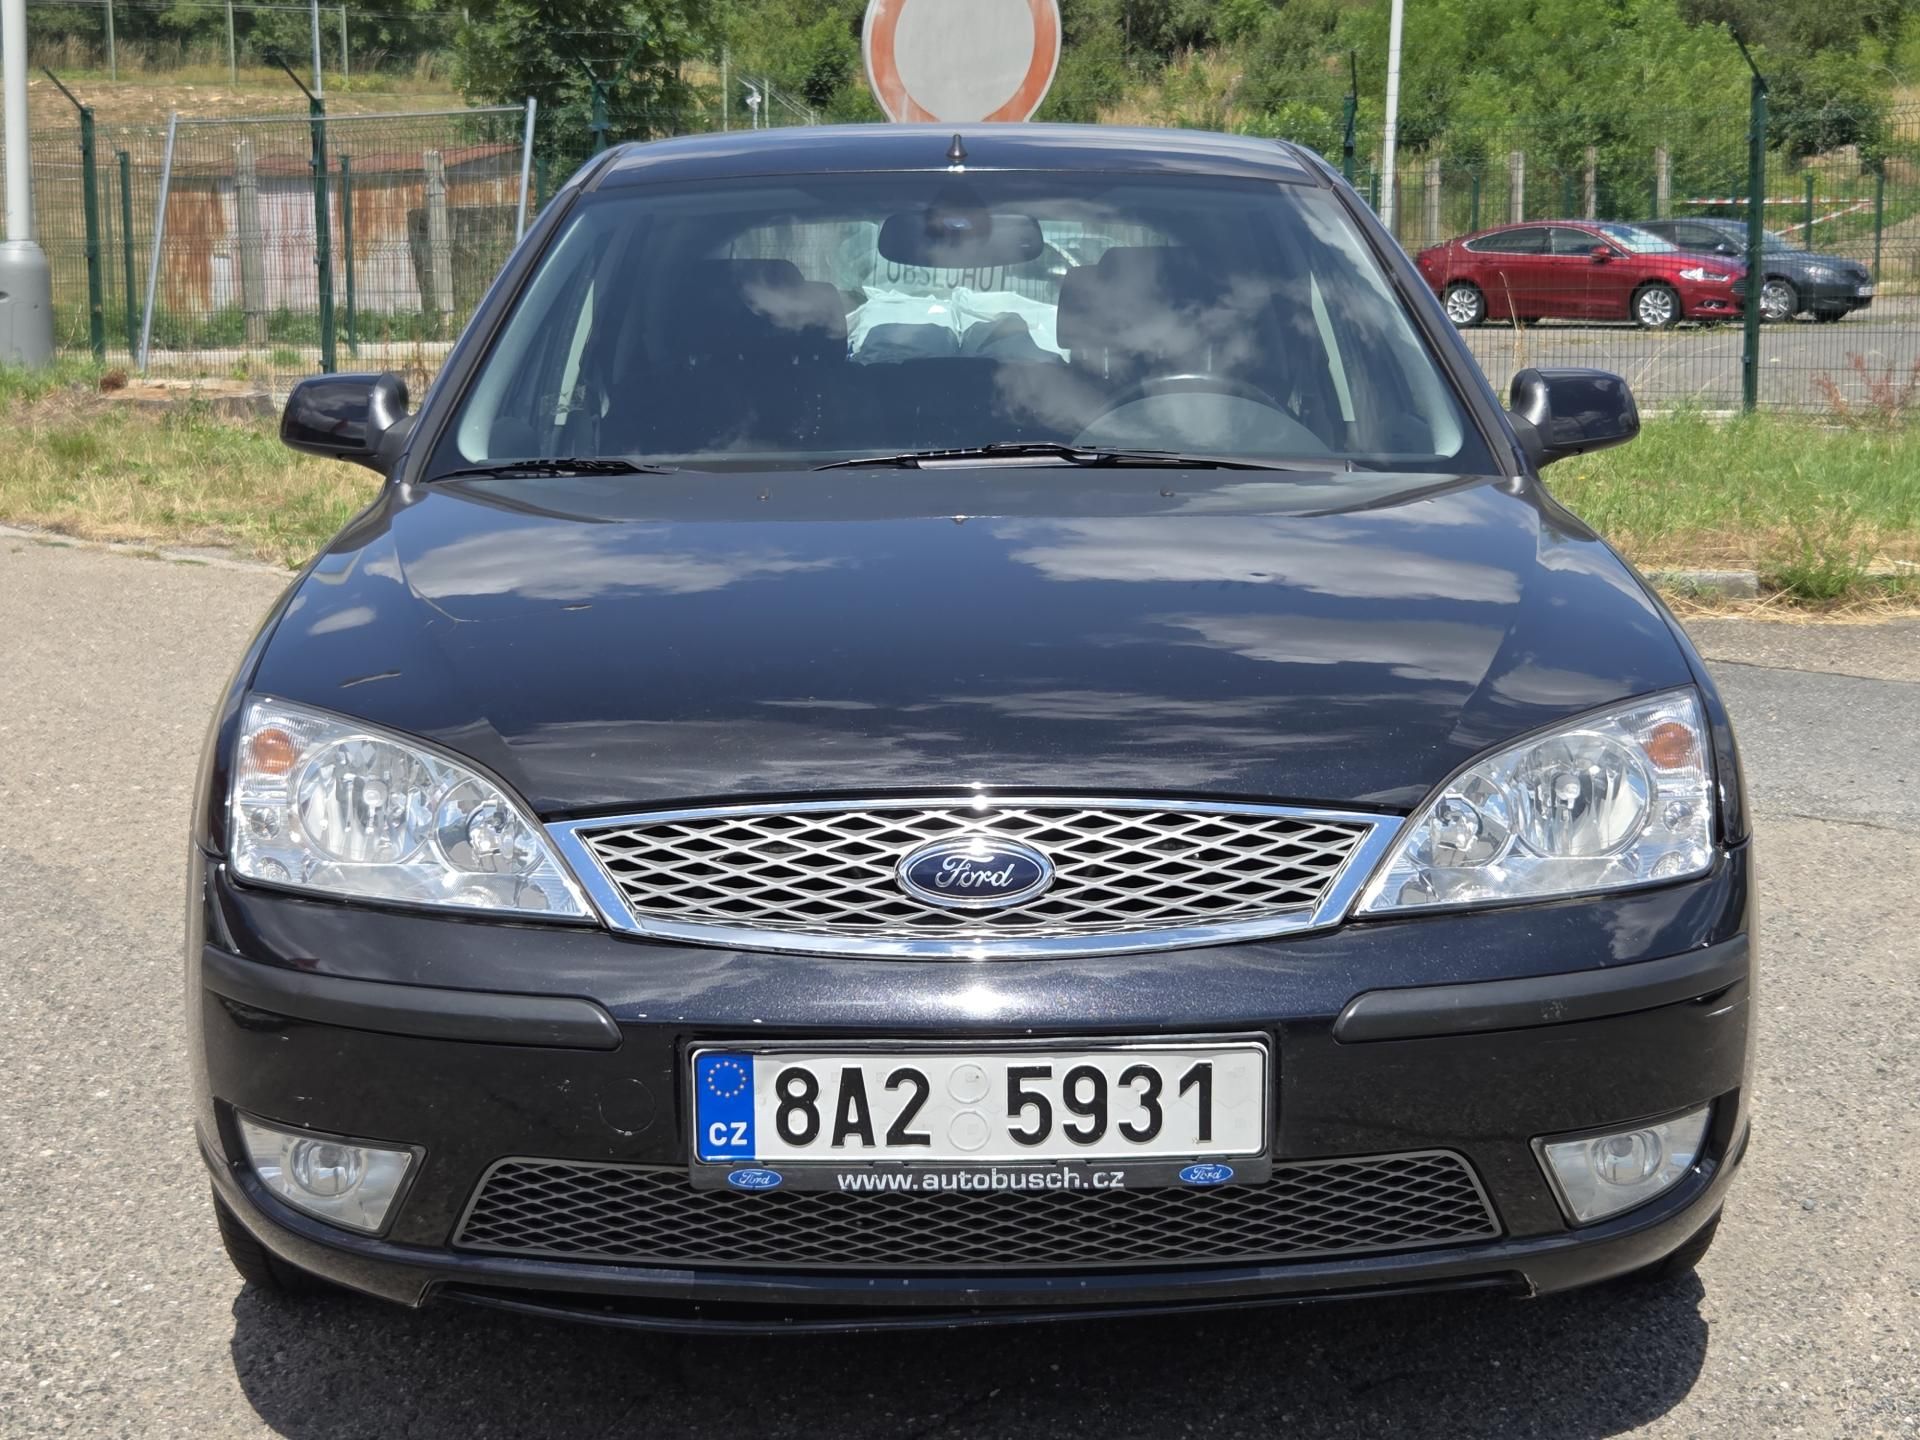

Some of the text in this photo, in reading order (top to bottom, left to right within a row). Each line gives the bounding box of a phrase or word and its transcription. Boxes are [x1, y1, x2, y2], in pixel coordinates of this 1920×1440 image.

[934, 854, 1016, 888] Ford
[774, 1062, 1213, 1147] 8A2 5931
[708, 1122, 748, 1145] CZ
[739, 1171, 771, 1185] Ford
[837, 1167, 1126, 1191] www.autobusch.cz
[1190, 1166, 1222, 1180] Ford
